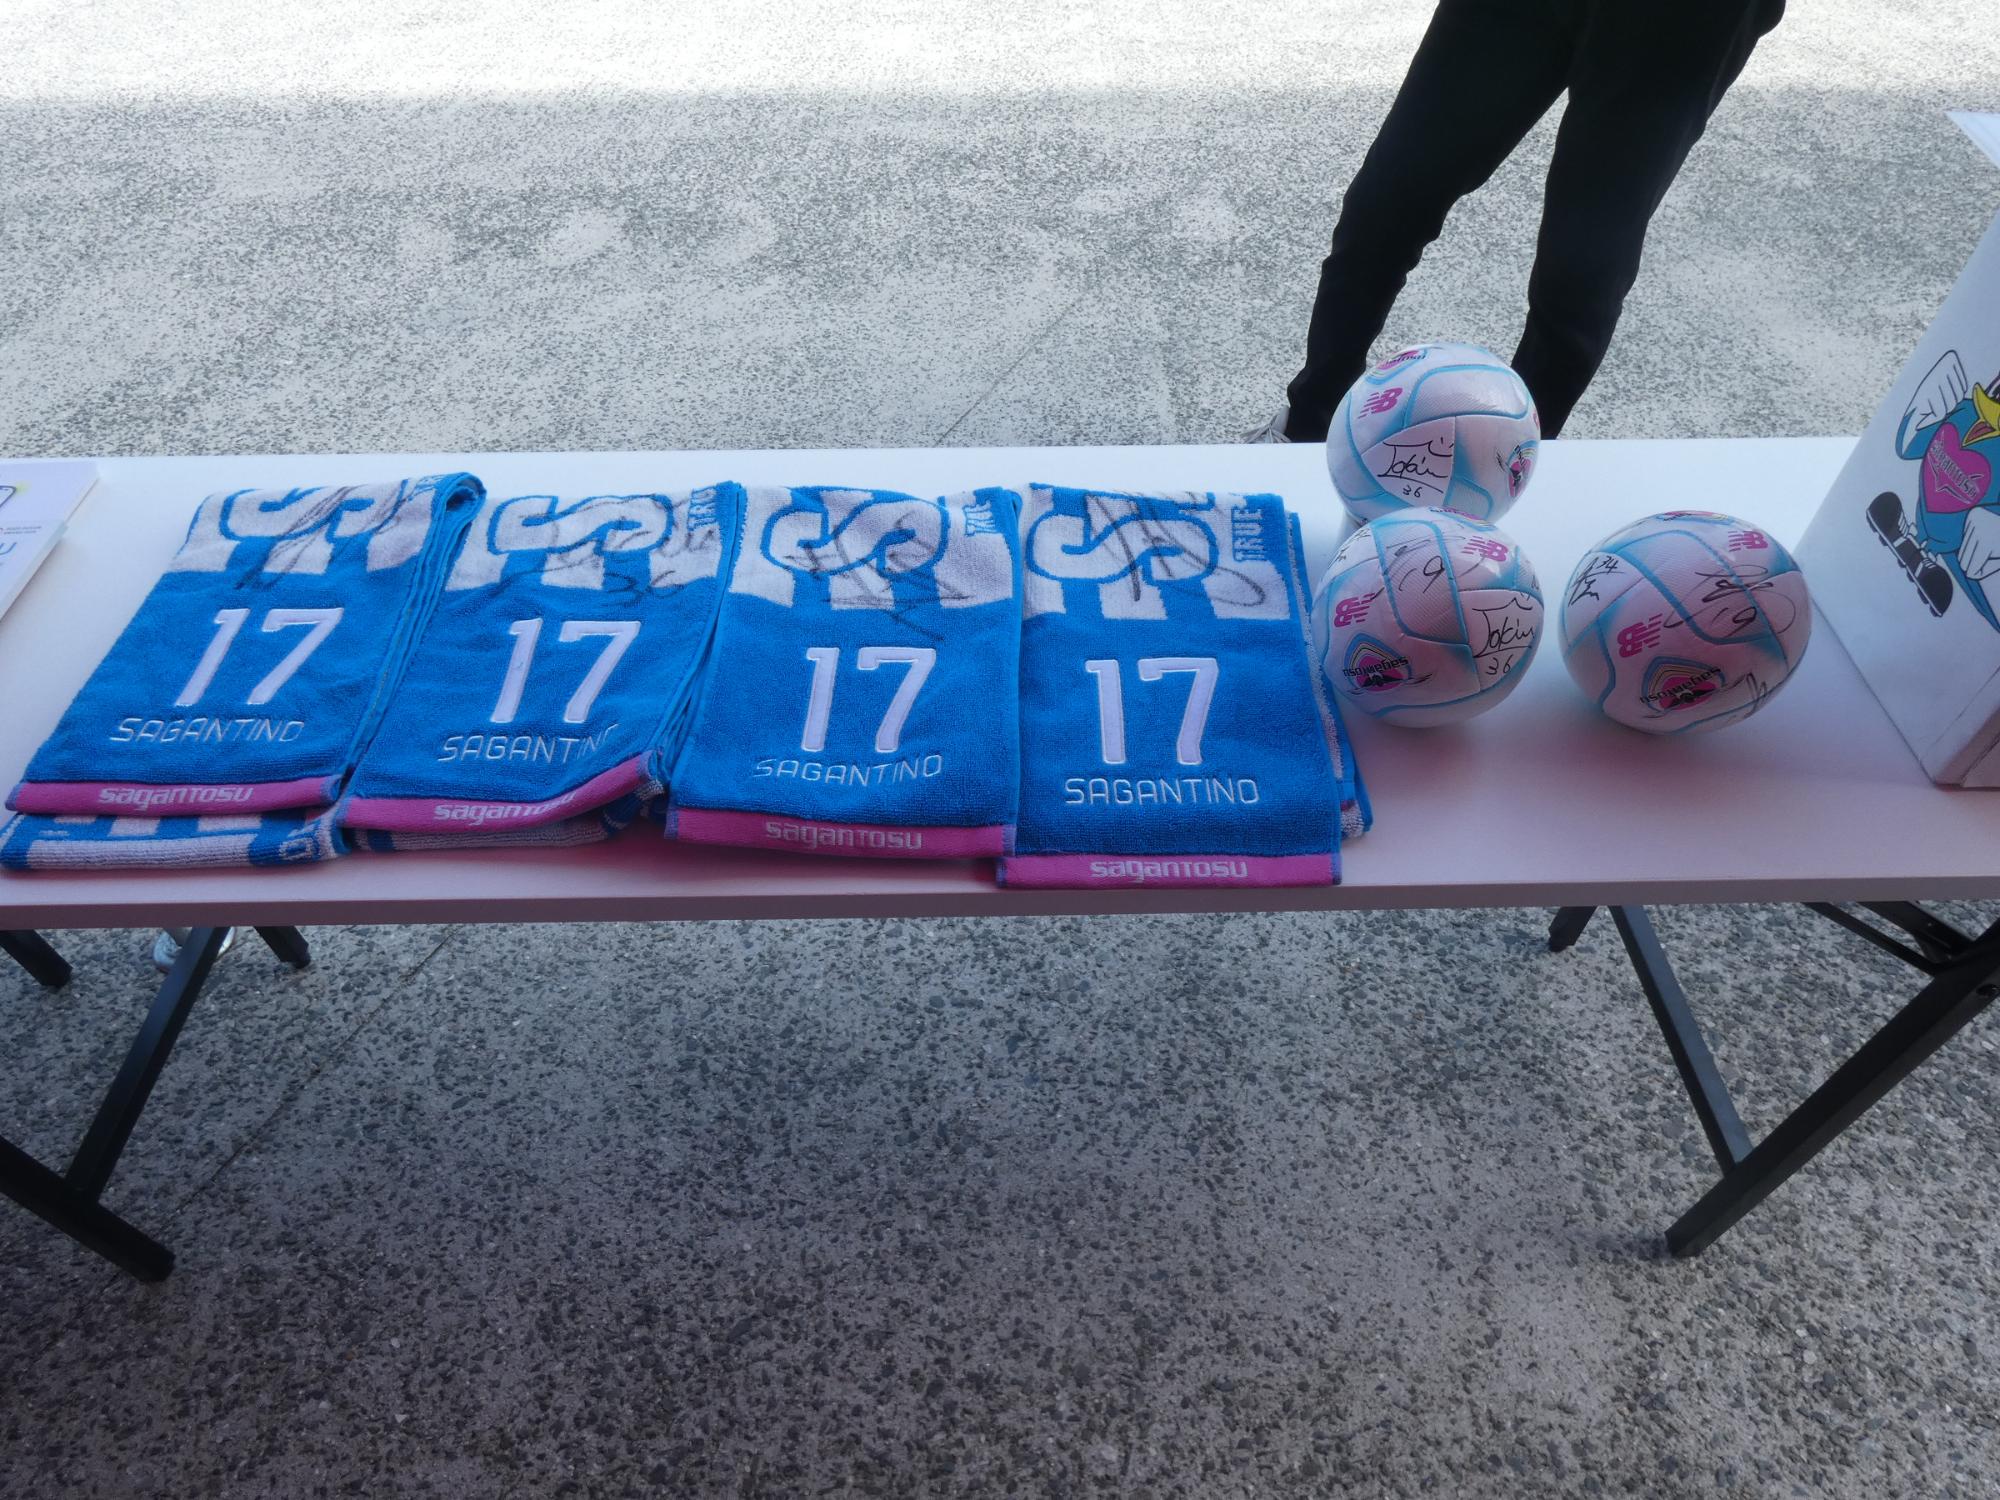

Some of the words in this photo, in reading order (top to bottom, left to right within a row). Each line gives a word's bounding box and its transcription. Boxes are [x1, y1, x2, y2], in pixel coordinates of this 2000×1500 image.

[174, 607, 345, 707] 17
[489, 617, 641, 724] 17
[801, 646, 937, 753] 17
[1084, 657, 1220, 766] 17
[109, 717, 305, 743] SAGANTINO
[752, 754, 944, 787] SAGANTINO
[98, 786, 254, 812] sagantosu
[1064, 777, 1260, 806] SAGANTINO
[765, 821, 922, 850] sagantosu
[1089, 859, 1249, 884] sagantosu
